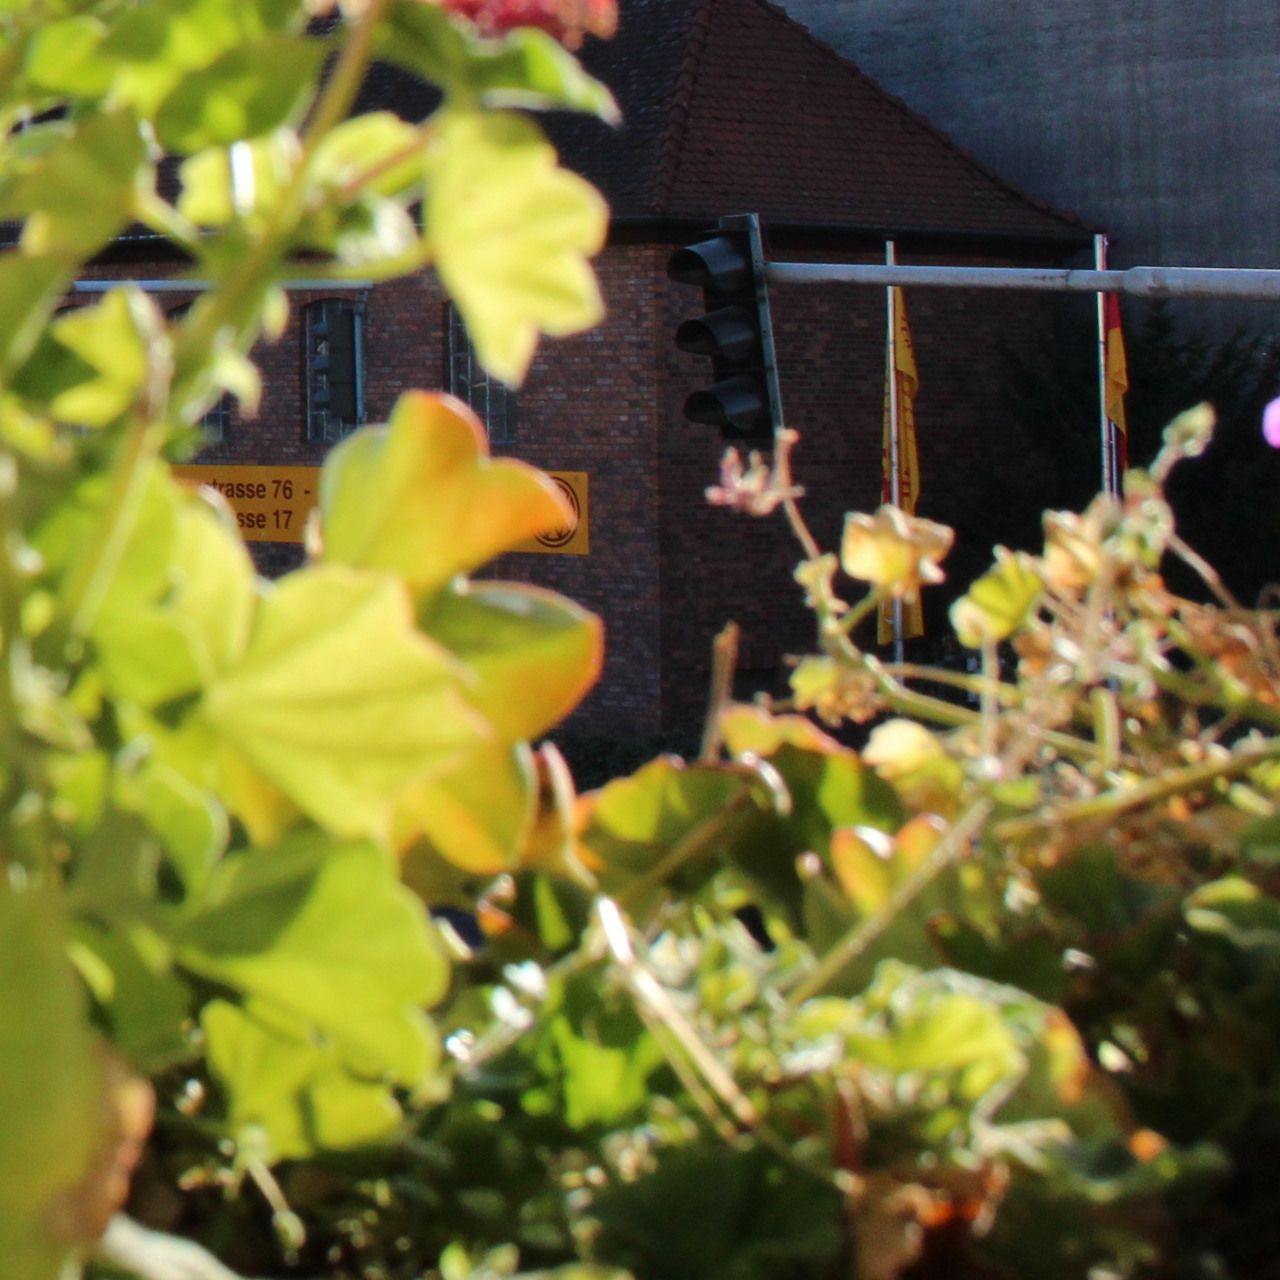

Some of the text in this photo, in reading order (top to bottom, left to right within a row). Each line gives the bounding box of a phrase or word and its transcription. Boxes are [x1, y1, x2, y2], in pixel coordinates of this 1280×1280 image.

[205, 479, 266, 499] trasse
[272, 480, 293, 500] 76
[273, 510, 293, 529] 17
